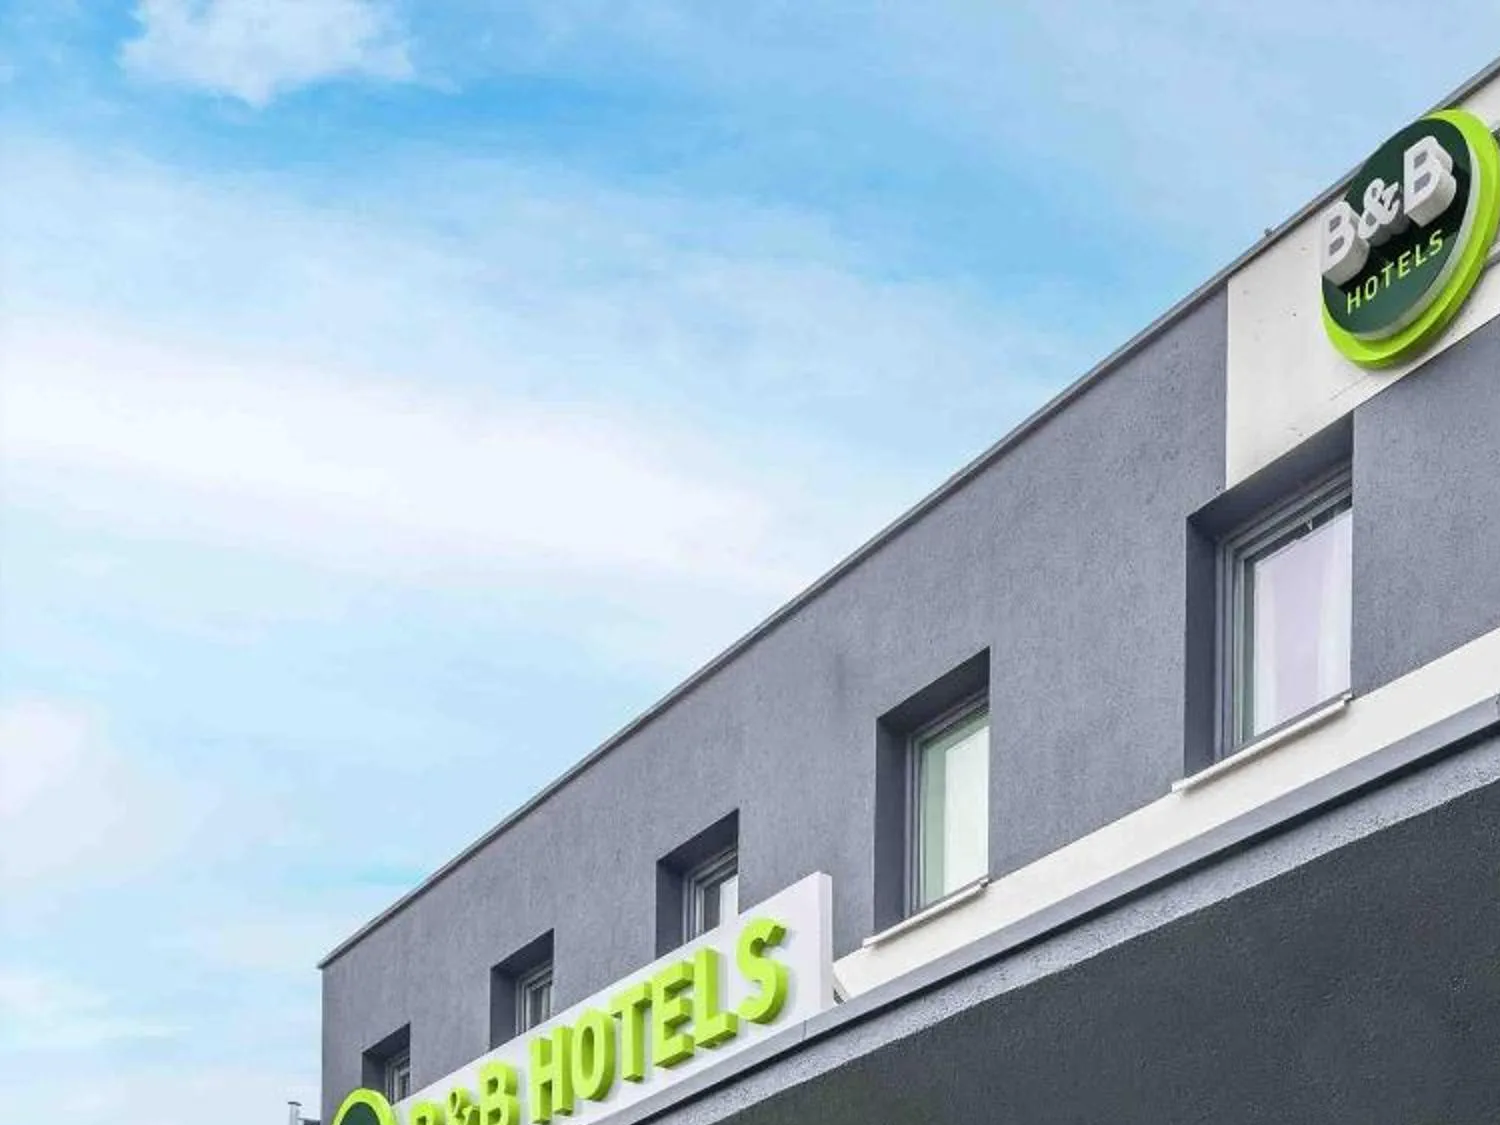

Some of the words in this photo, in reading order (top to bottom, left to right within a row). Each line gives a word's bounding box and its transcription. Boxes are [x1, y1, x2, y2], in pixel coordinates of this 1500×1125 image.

[1320, 135, 1457, 287] B&B
[1346, 228, 1445, 315] HOTELS
[530, 916, 788, 1125] HOTELS
